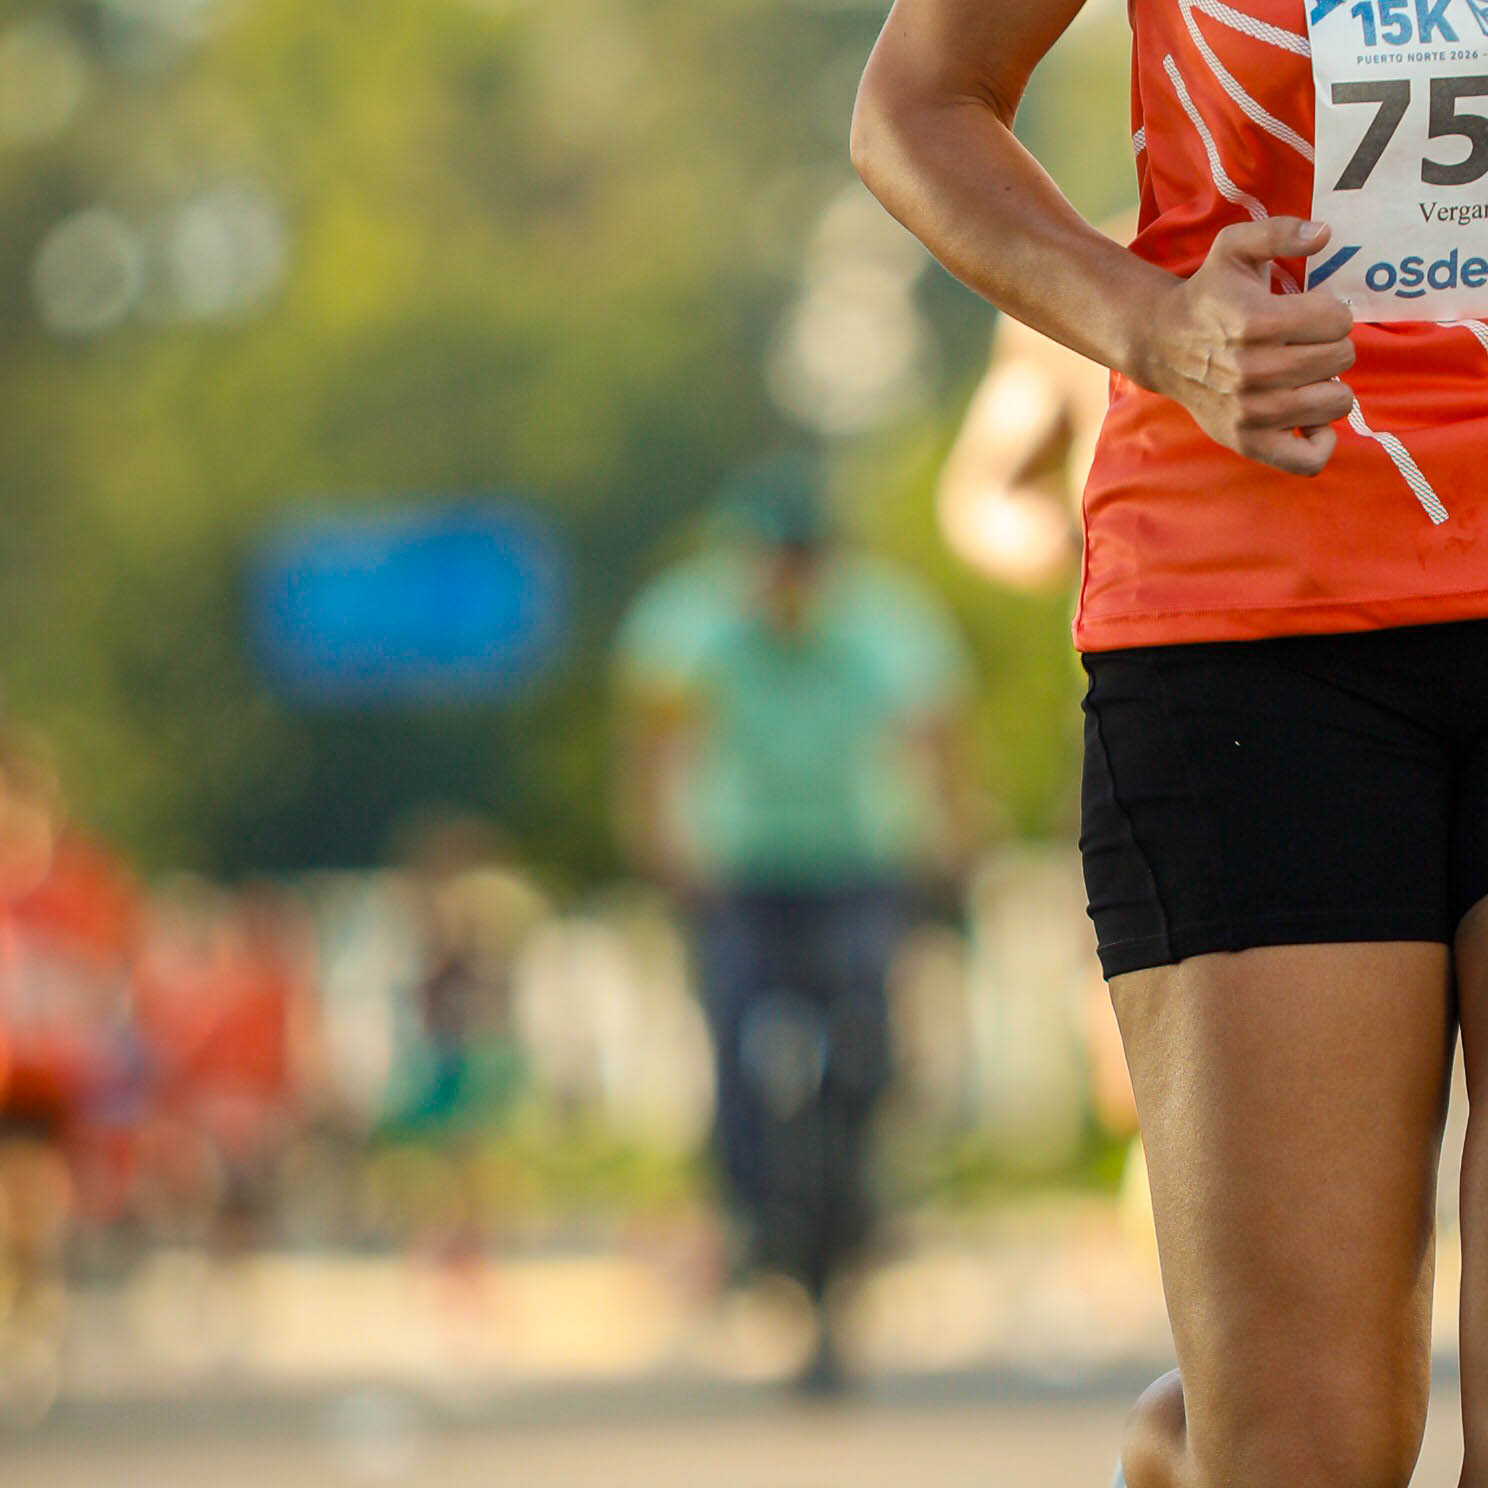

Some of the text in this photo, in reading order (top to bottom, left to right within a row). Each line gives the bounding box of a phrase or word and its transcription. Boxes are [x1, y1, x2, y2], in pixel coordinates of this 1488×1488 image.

[1356, 54, 1403, 65] PUERTO
[1407, 51, 1446, 62] NORTE
[1450, 49, 1479, 60] 2026
